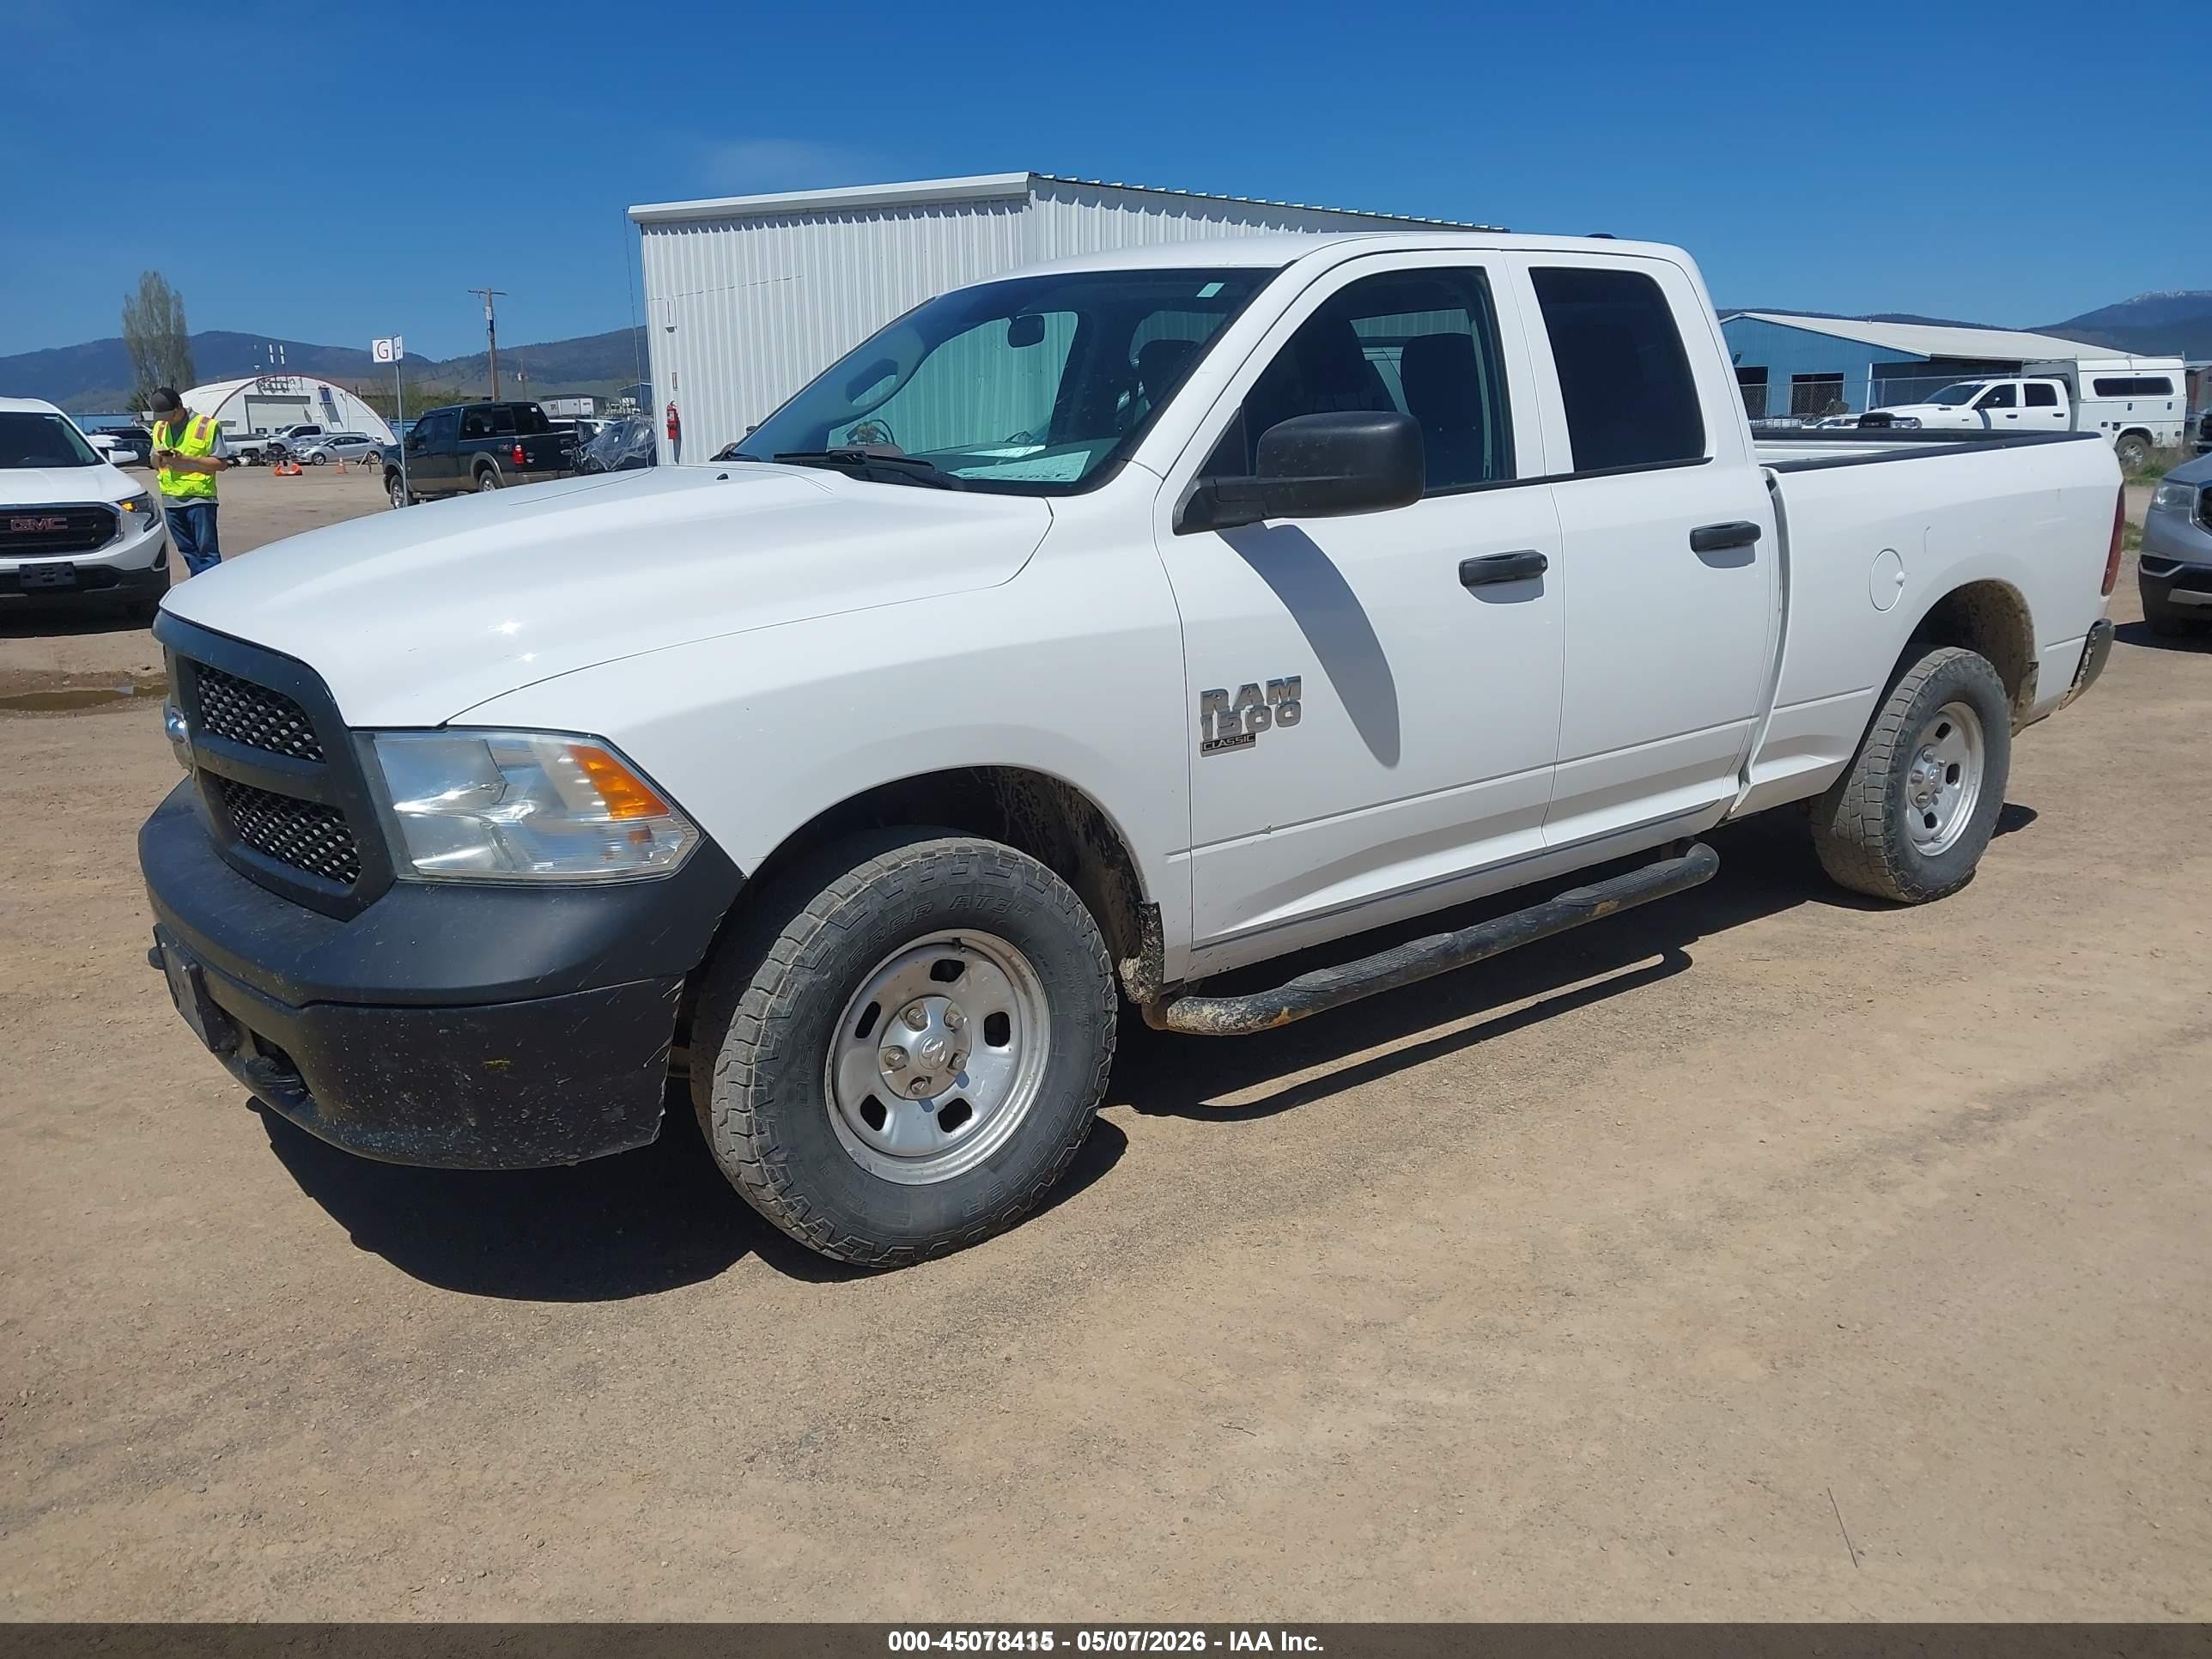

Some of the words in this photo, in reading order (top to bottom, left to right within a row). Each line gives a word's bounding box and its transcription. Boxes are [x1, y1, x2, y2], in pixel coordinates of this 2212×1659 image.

[377, 340, 389, 359] G
[395, 337, 402, 359] H
[10, 517, 69, 532] GMC
[1200, 675, 1302, 715] RAM
[1200, 701, 1302, 741] 1500
[1202, 734, 1255, 751] CLASSIC
